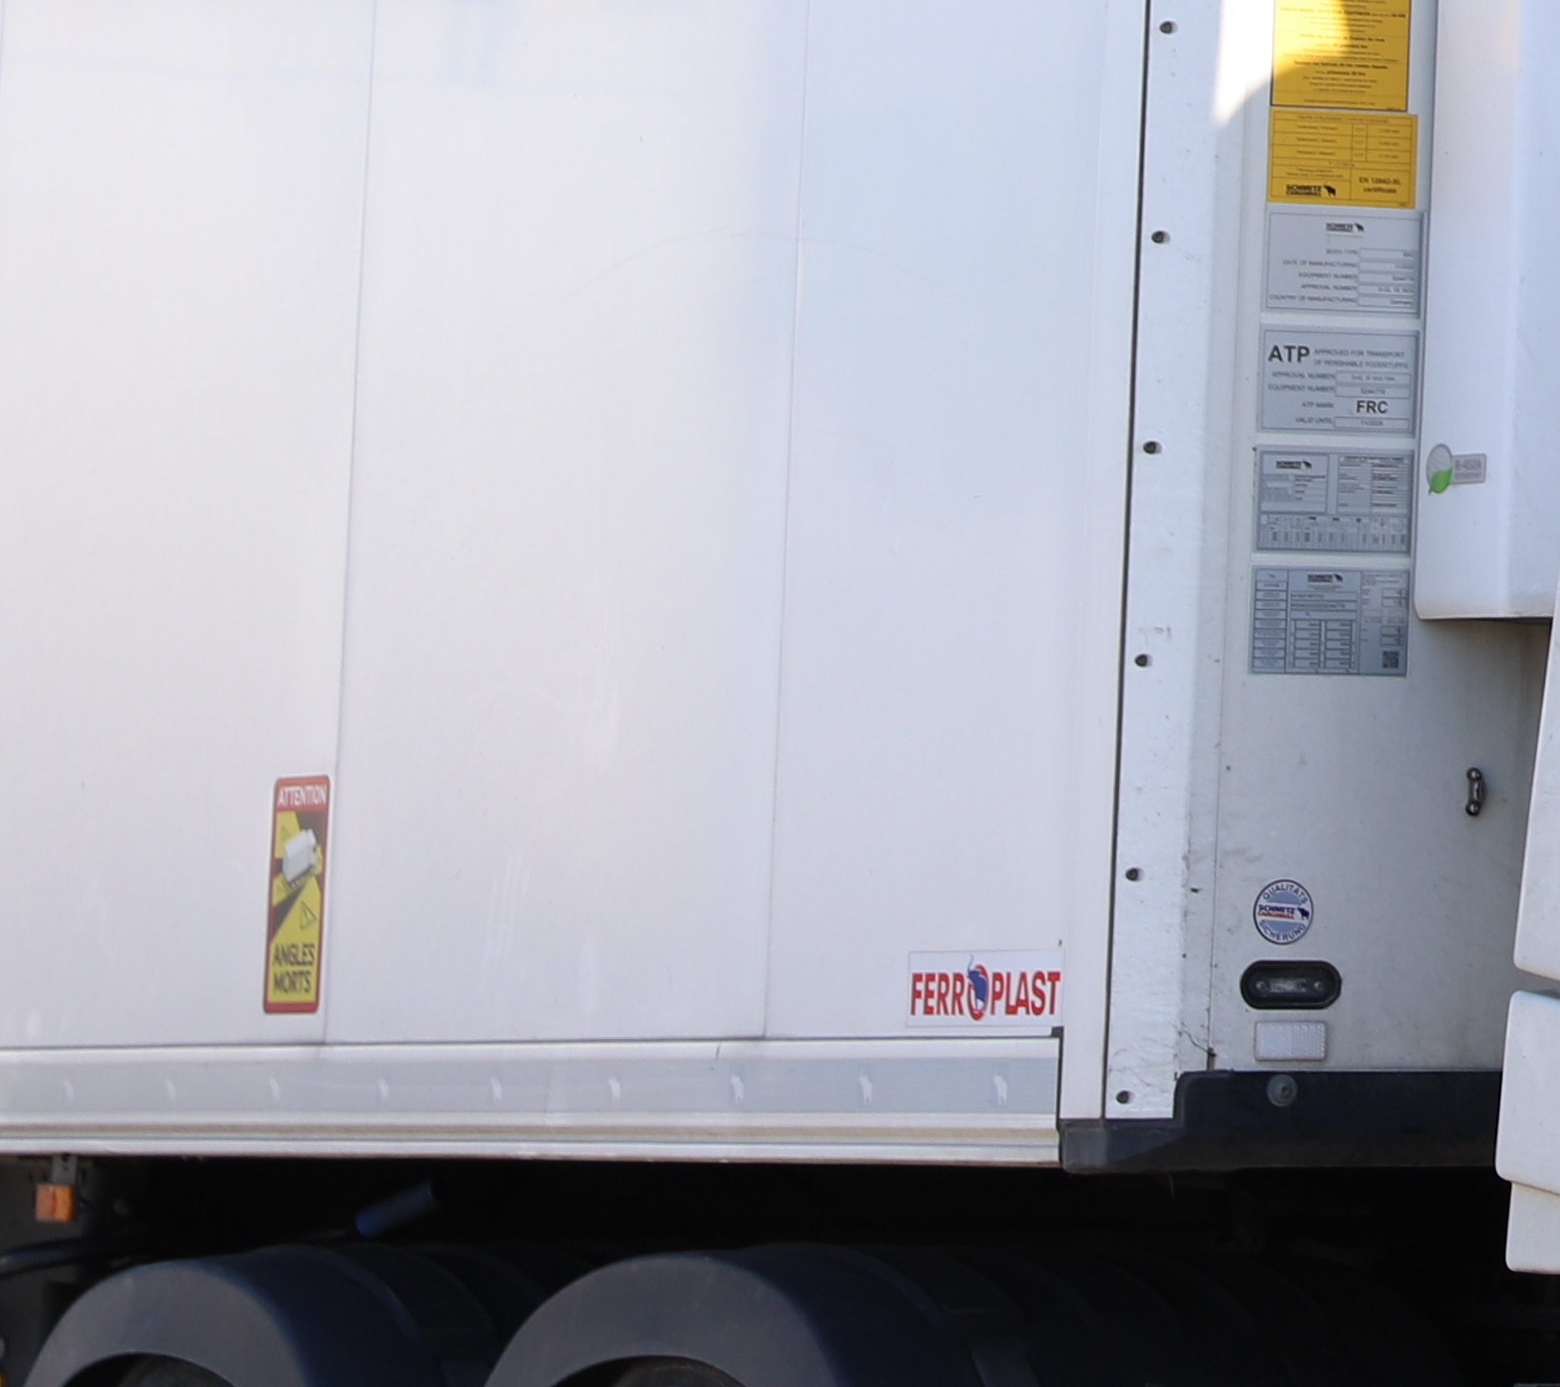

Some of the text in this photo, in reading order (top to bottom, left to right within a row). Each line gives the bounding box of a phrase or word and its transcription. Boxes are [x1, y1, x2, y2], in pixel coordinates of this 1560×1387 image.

[1267, 344, 1310, 363] ATP
[1356, 400, 1389, 414] FRC
[277, 783, 328, 807] ATTENTION
[273, 943, 316, 967] ANGLES
[273, 969, 312, 995] MORTS
[909, 964, 1062, 1022] FERROPLAST
